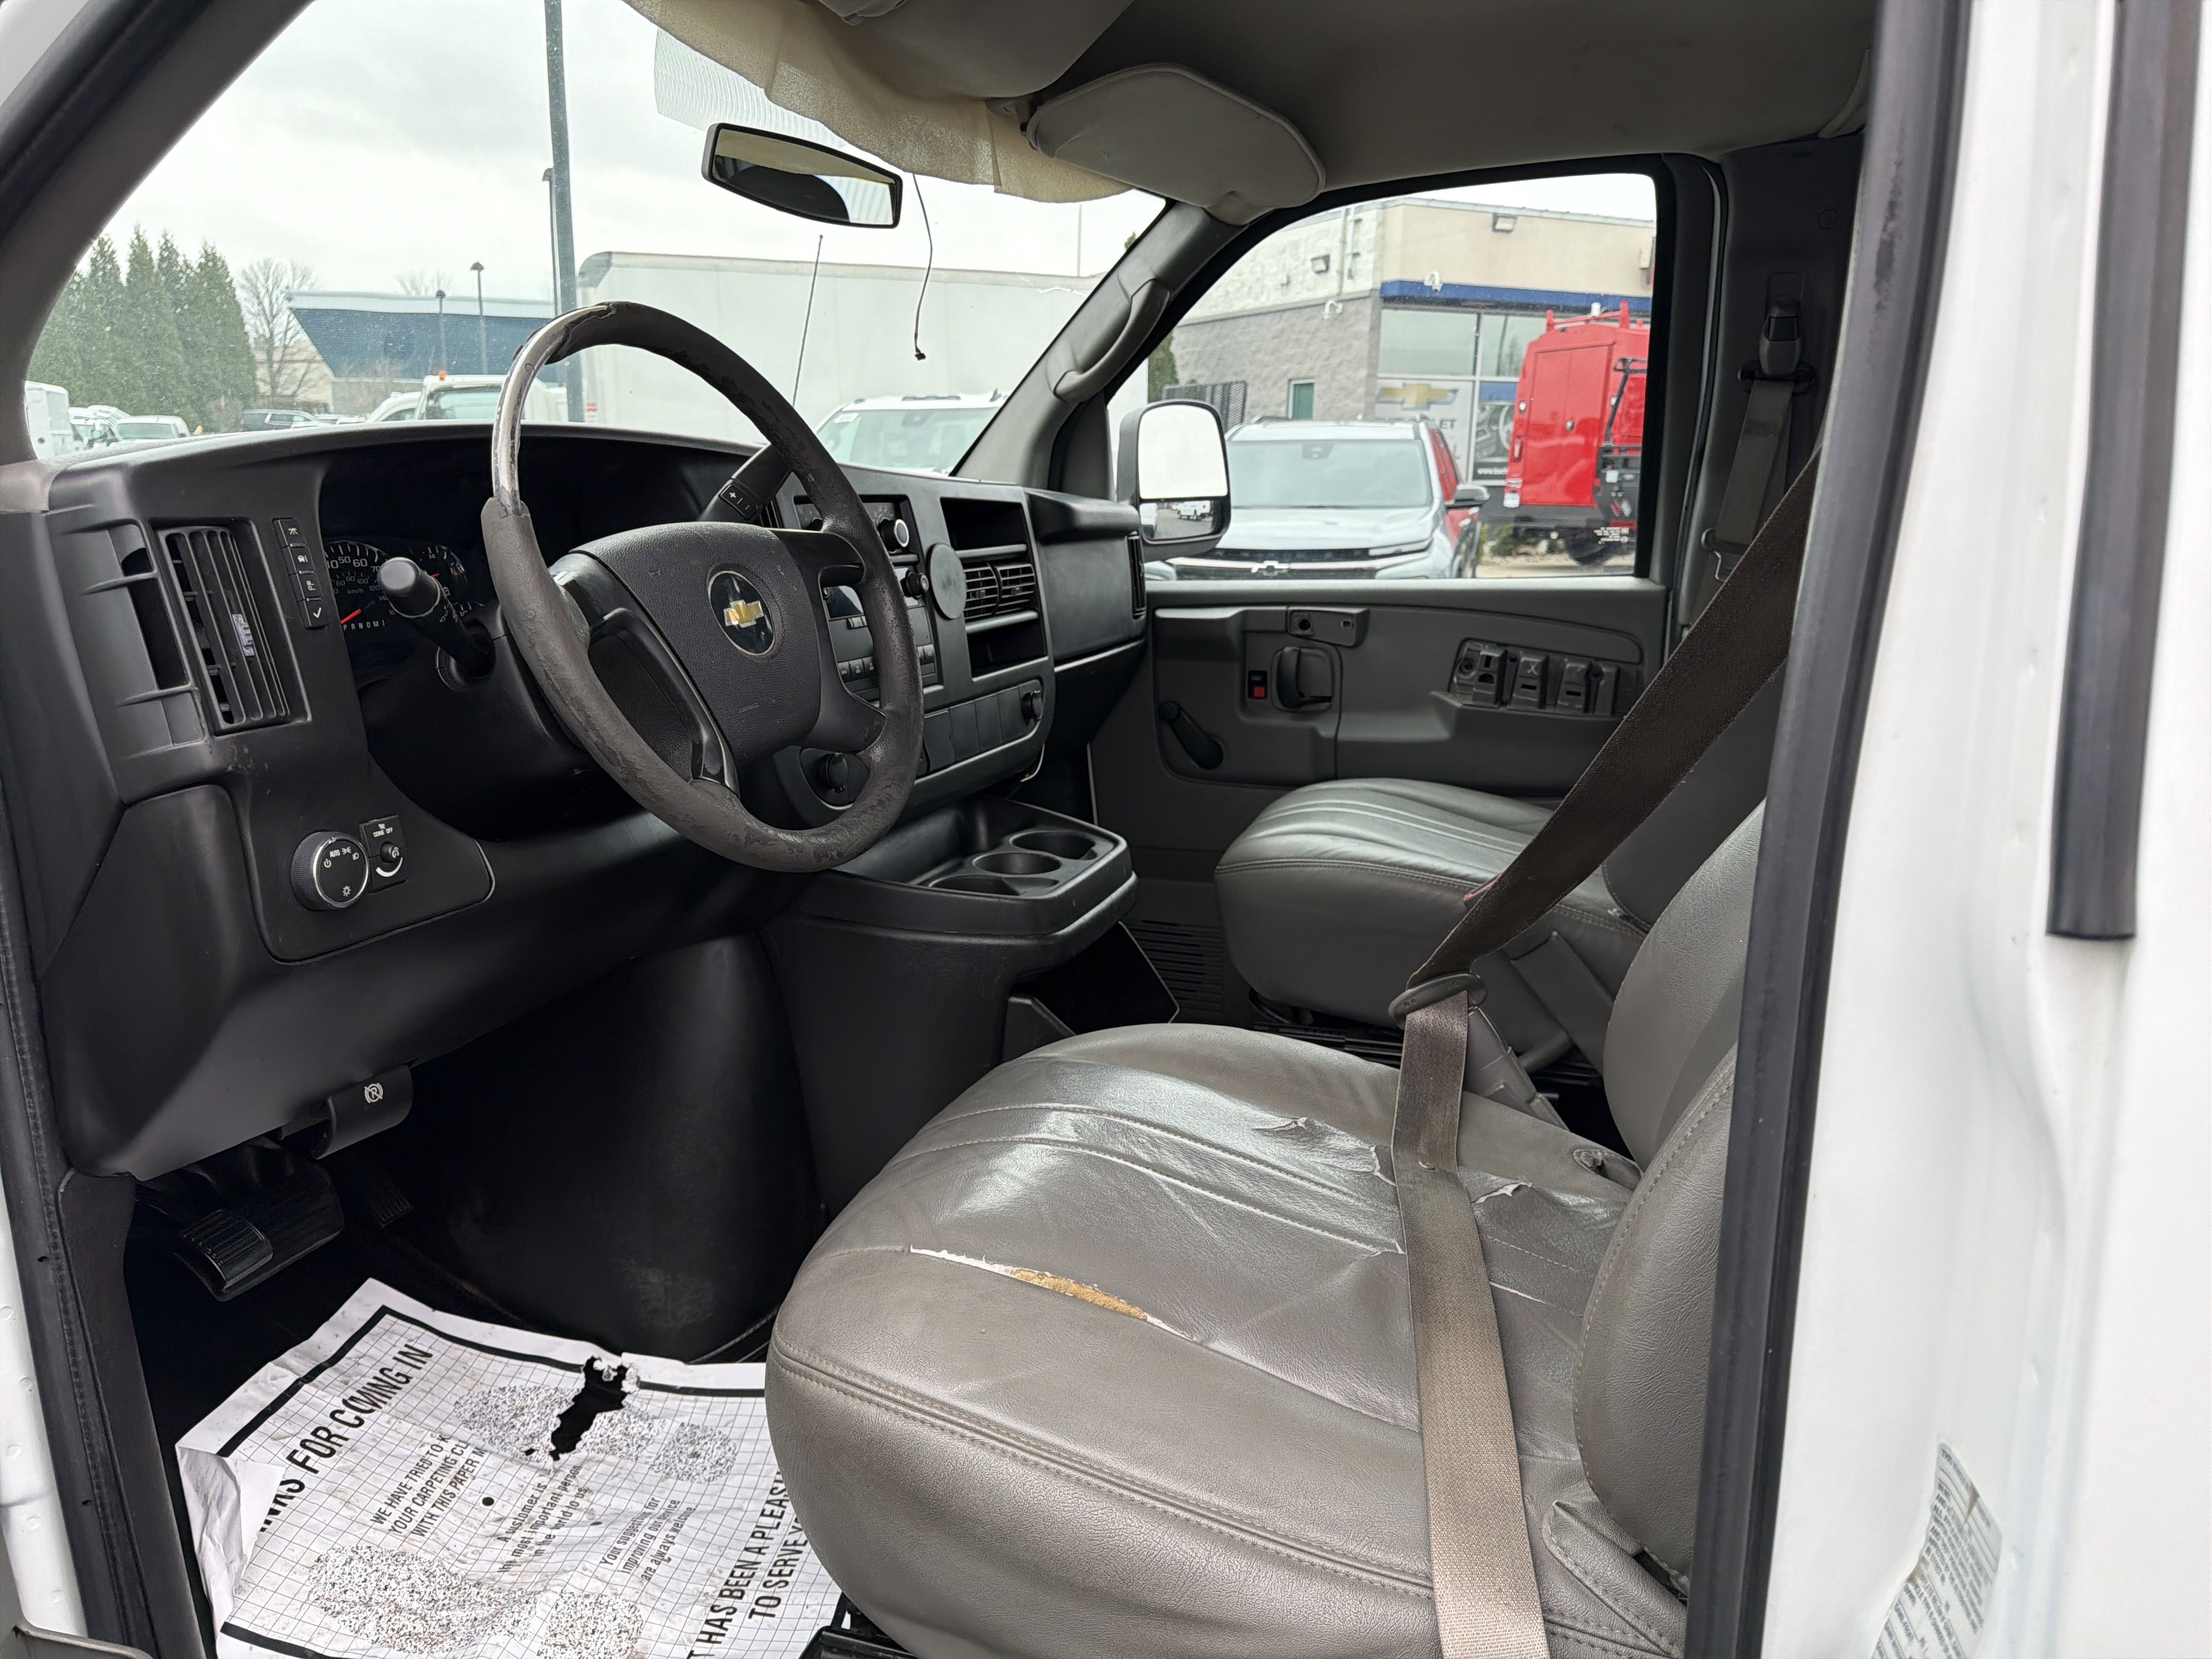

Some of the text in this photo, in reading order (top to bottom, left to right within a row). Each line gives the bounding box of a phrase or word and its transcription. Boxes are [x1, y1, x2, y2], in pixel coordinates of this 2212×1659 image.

[338, 556, 351, 564] 50
[353, 558, 368, 567] 60
[330, 849, 340, 858] AUTO
[286, 1344, 433, 1474] FOR COMING IN
[370, 1508, 392, 1525] WE
[385, 1482, 413, 1509] HAVE
[404, 1456, 433, 1482] TRIED
[426, 1443, 444, 1458] TO
[388, 1506, 419, 1534] YOUR
[412, 1456, 458, 1506] CARPETING
[411, 1511, 439, 1537] WITH
[431, 1489, 456, 1512] THIS
[449, 1458, 480, 1491] PAPER
[511, 1537, 534, 1558] most
[557, 1465, 583, 1492] person
[532, 1483, 548, 1493] is
[529, 1549, 546, 1557] in
[565, 1500, 580, 1510] to
[599, 1547, 623, 1565] Your
[644, 1497, 661, 1510] for
[617, 1532, 657, 1575] improving
[648, 1520, 663, 1532] our
[640, 1566, 656, 1582] are
[650, 1533, 675, 1566] always
[763, 1539, 808, 1589] SERVE
[696, 1604, 738, 1645] HAS
[718, 1559, 762, 1600] BEEN
[743, 1545, 770, 1556] A
[748, 1596, 782, 1619] TO
